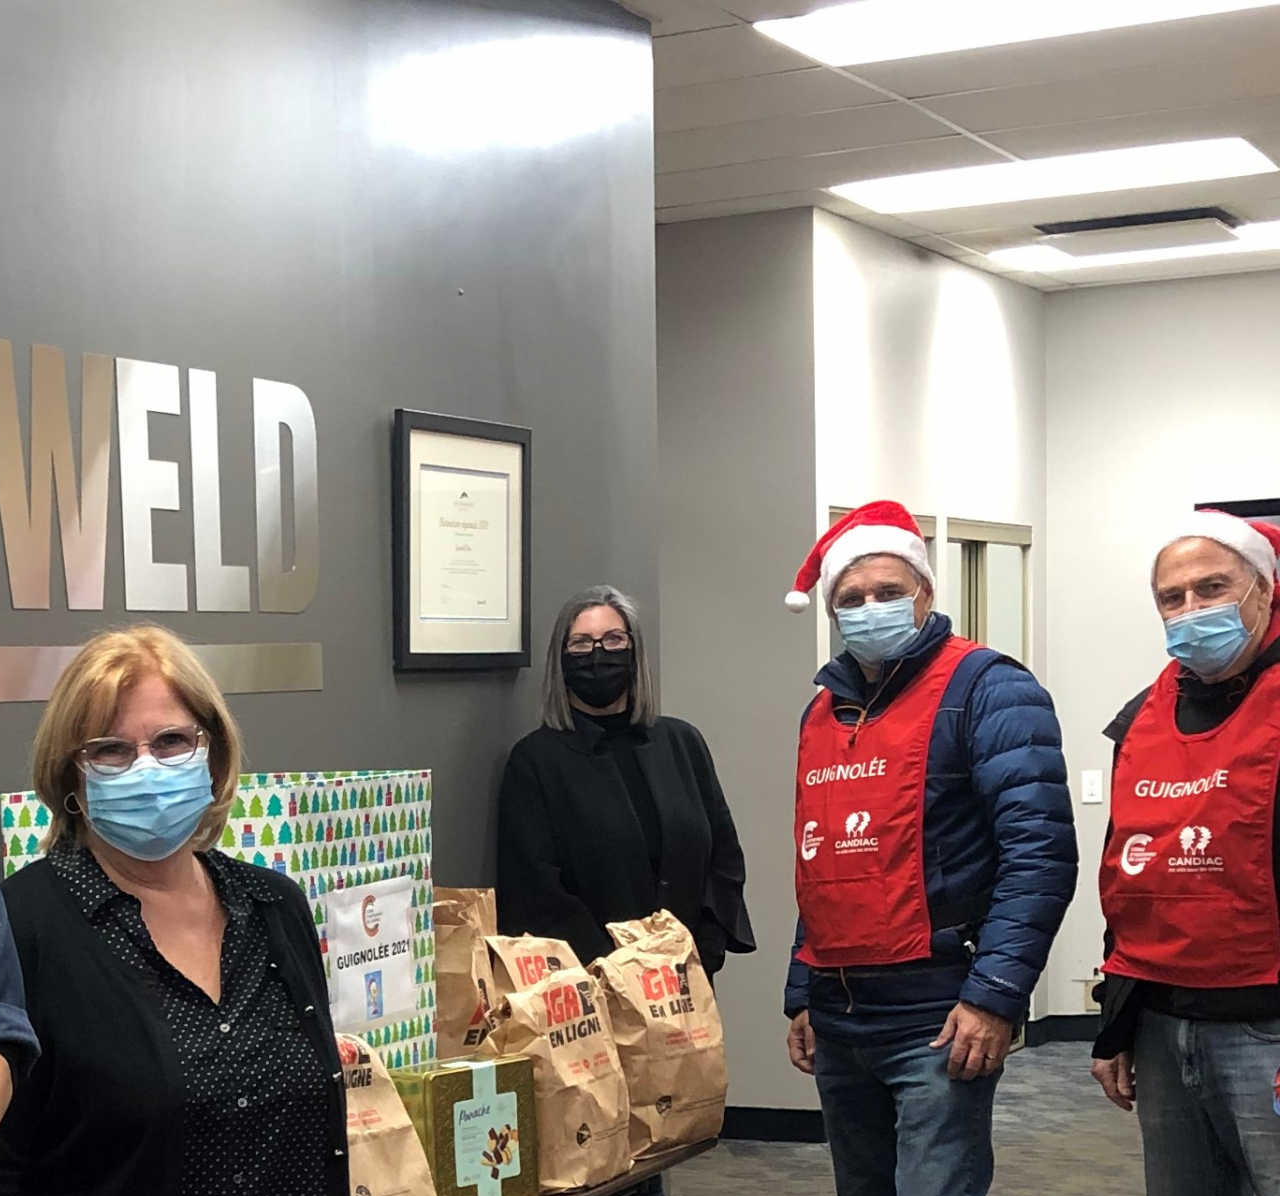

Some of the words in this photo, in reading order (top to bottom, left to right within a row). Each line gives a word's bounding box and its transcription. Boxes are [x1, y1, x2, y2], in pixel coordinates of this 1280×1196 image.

[805, 756, 887, 786] GUIGNOLÉE
[834, 837, 879, 849] CANDIAC
[1167, 856, 1224, 867] CANDIAC
[336, 943, 390, 970] GUIGNOLÉE
[542, 984, 581, 1028] IGA
[549, 1031, 565, 1049] EN
